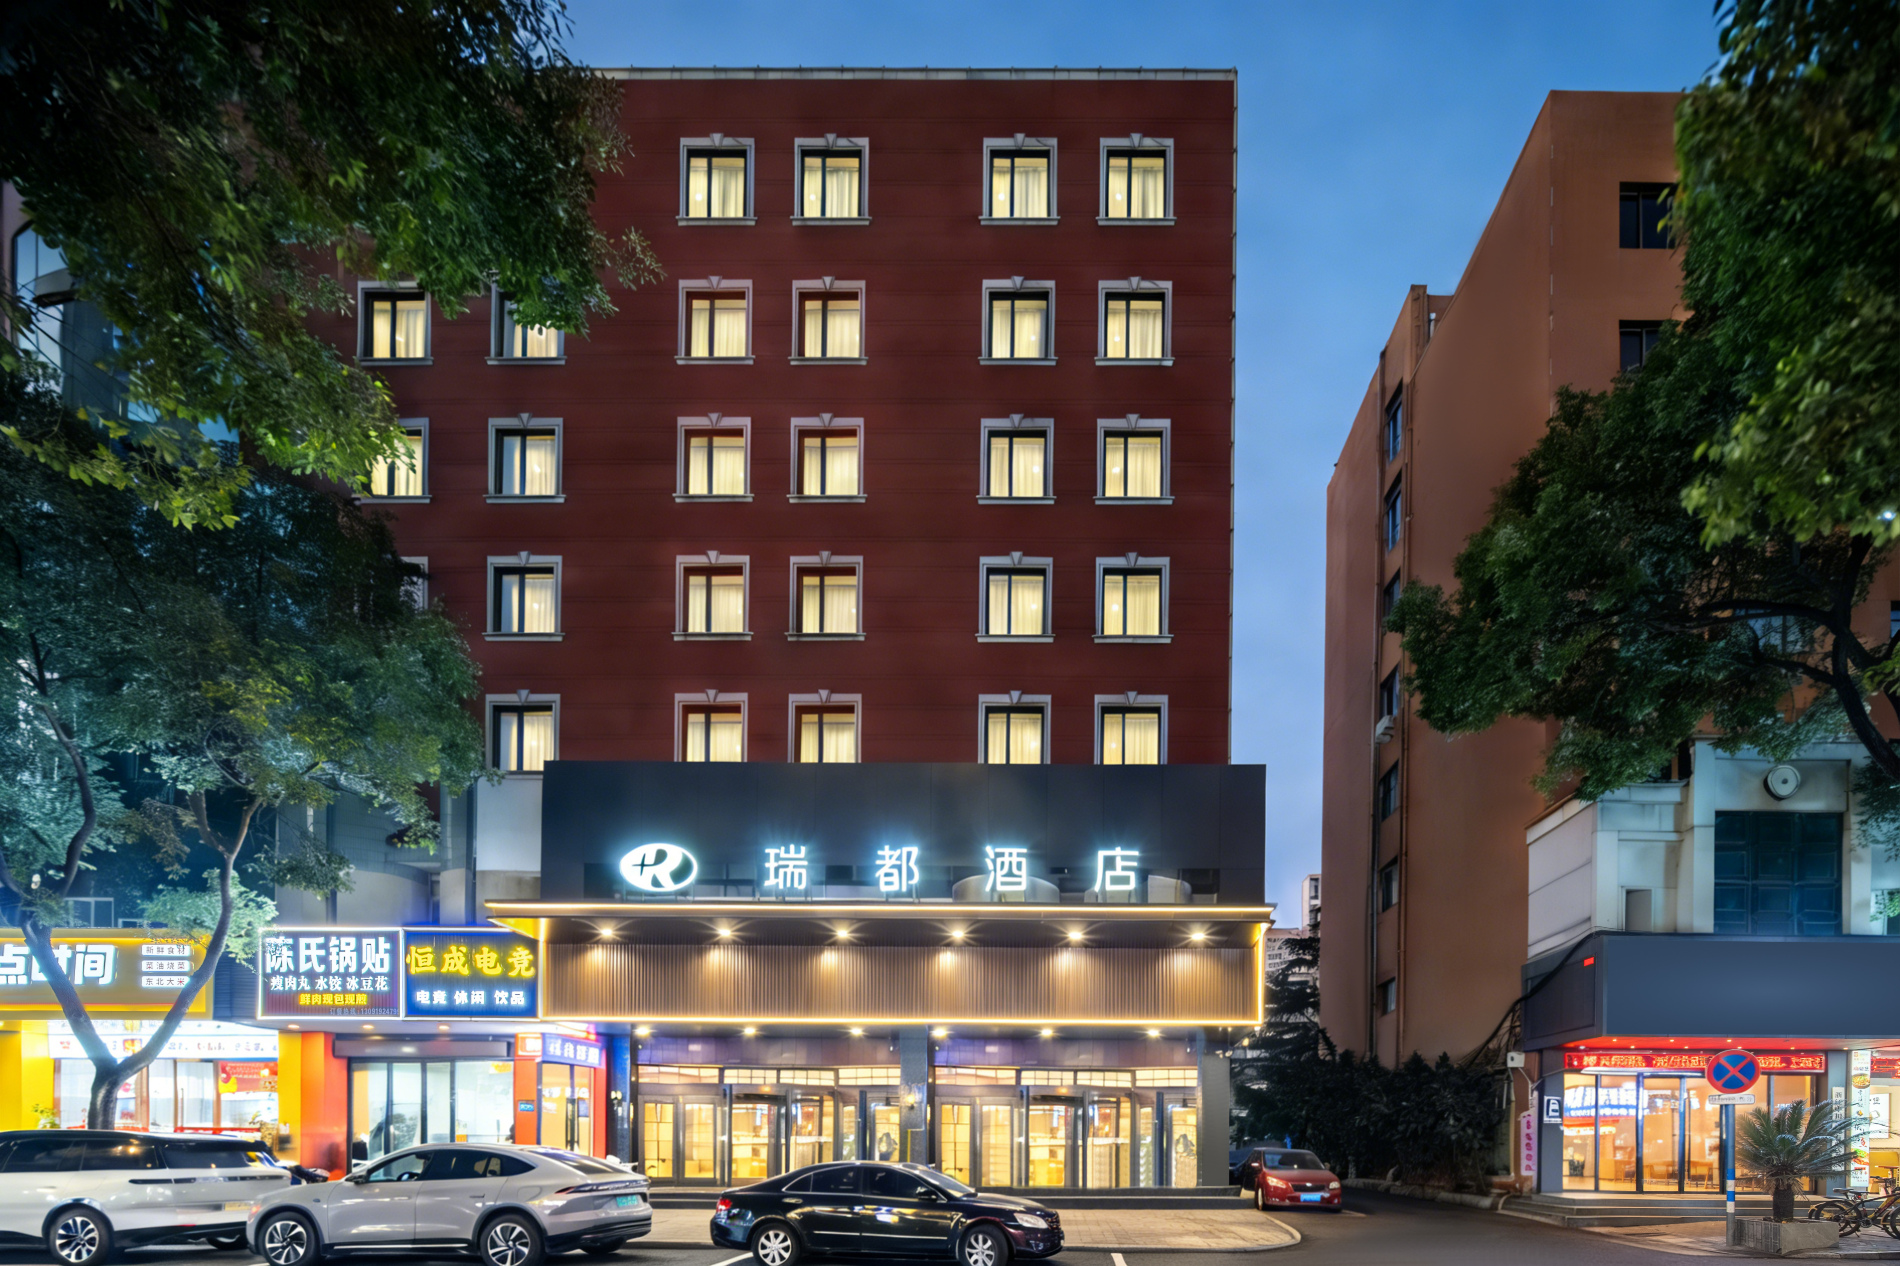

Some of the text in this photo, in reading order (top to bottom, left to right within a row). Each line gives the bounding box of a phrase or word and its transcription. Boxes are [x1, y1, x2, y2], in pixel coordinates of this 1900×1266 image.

[764, 843, 1141, 893] 瑞都酒店
[146, 946, 186, 955] 新鲜食材
[265, 936, 391, 973] 陈氏锅贴
[406, 945, 536, 978] 恒成电竞
[145, 977, 186, 986] 东北大米
[270, 975, 389, 991] 瘦肉丸 水饺 冰豆花
[299, 993, 368, 1006] 鲜肉现包现煎
[416, 990, 525, 1005] 电竞 休闲 饮品
